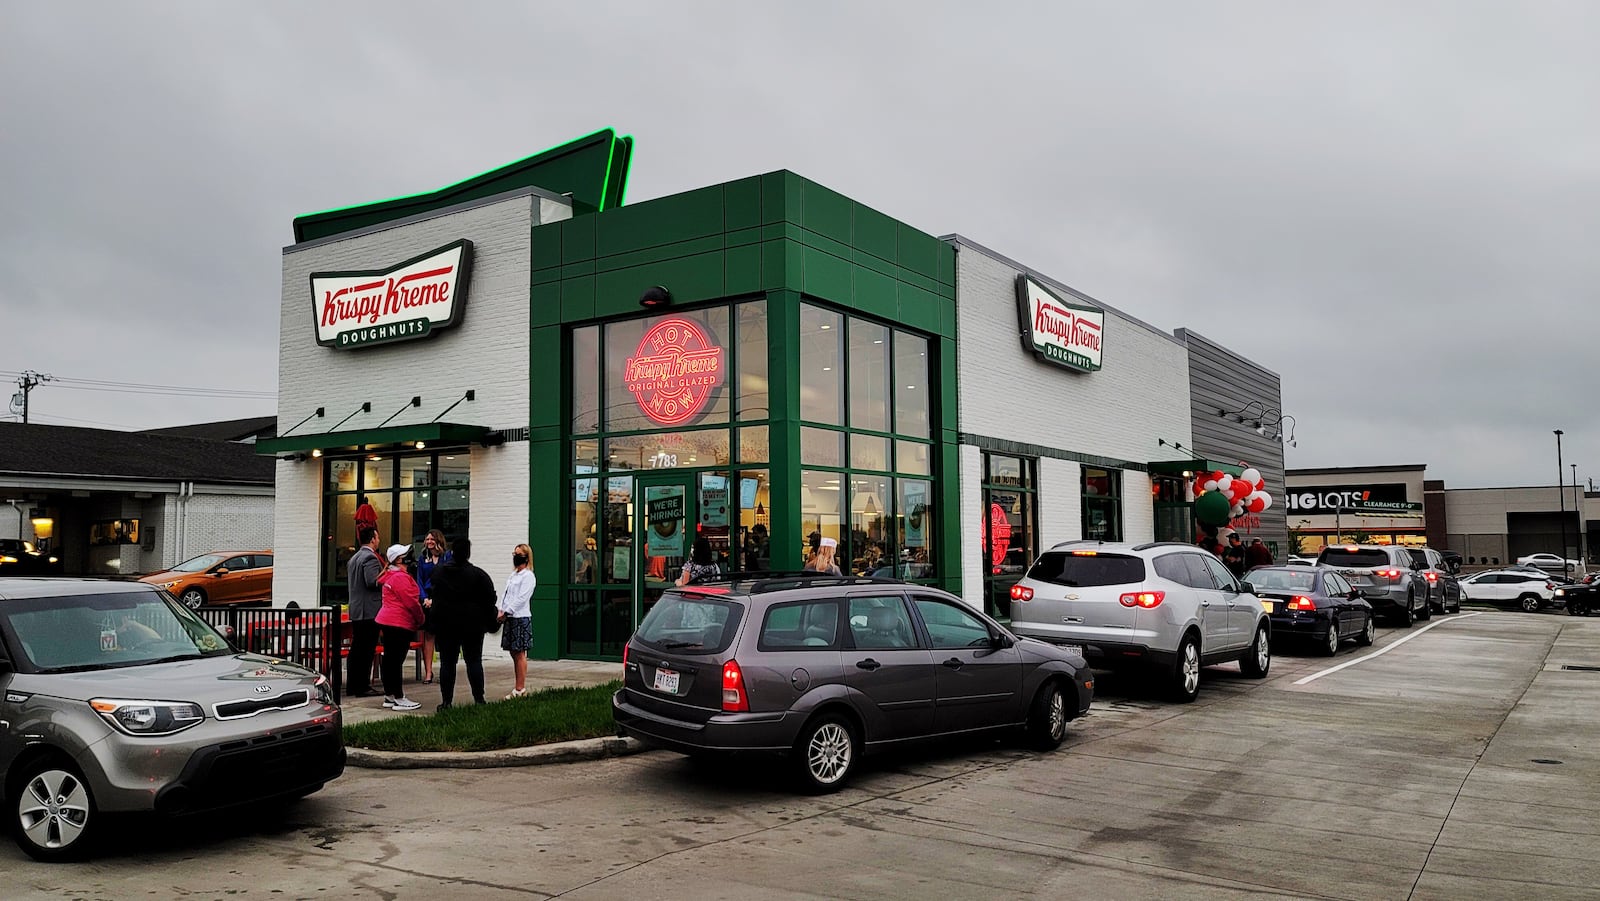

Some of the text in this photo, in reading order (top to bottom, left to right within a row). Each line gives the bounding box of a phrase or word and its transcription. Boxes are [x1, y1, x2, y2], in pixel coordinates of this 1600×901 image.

[321, 265, 454, 327] Krispy Kreme
[342, 321, 424, 345] DOUGHNUTS
[1035, 298, 1101, 352] Krispy Kreme
[650, 327, 692, 351] HOT
[625, 347, 720, 382] Krispy Kreme
[1047, 346, 1090, 368] DOUGHNUTS
[629, 376, 716, 392] ORIGINAL GLAZED
[649, 387, 694, 416] NOW
[650, 454, 677, 468] 7783
[650, 508, 682, 521] HIRING!
[653, 499, 678, 511] WE'RE
[1363, 501, 1400, 509] CLEARANCE
